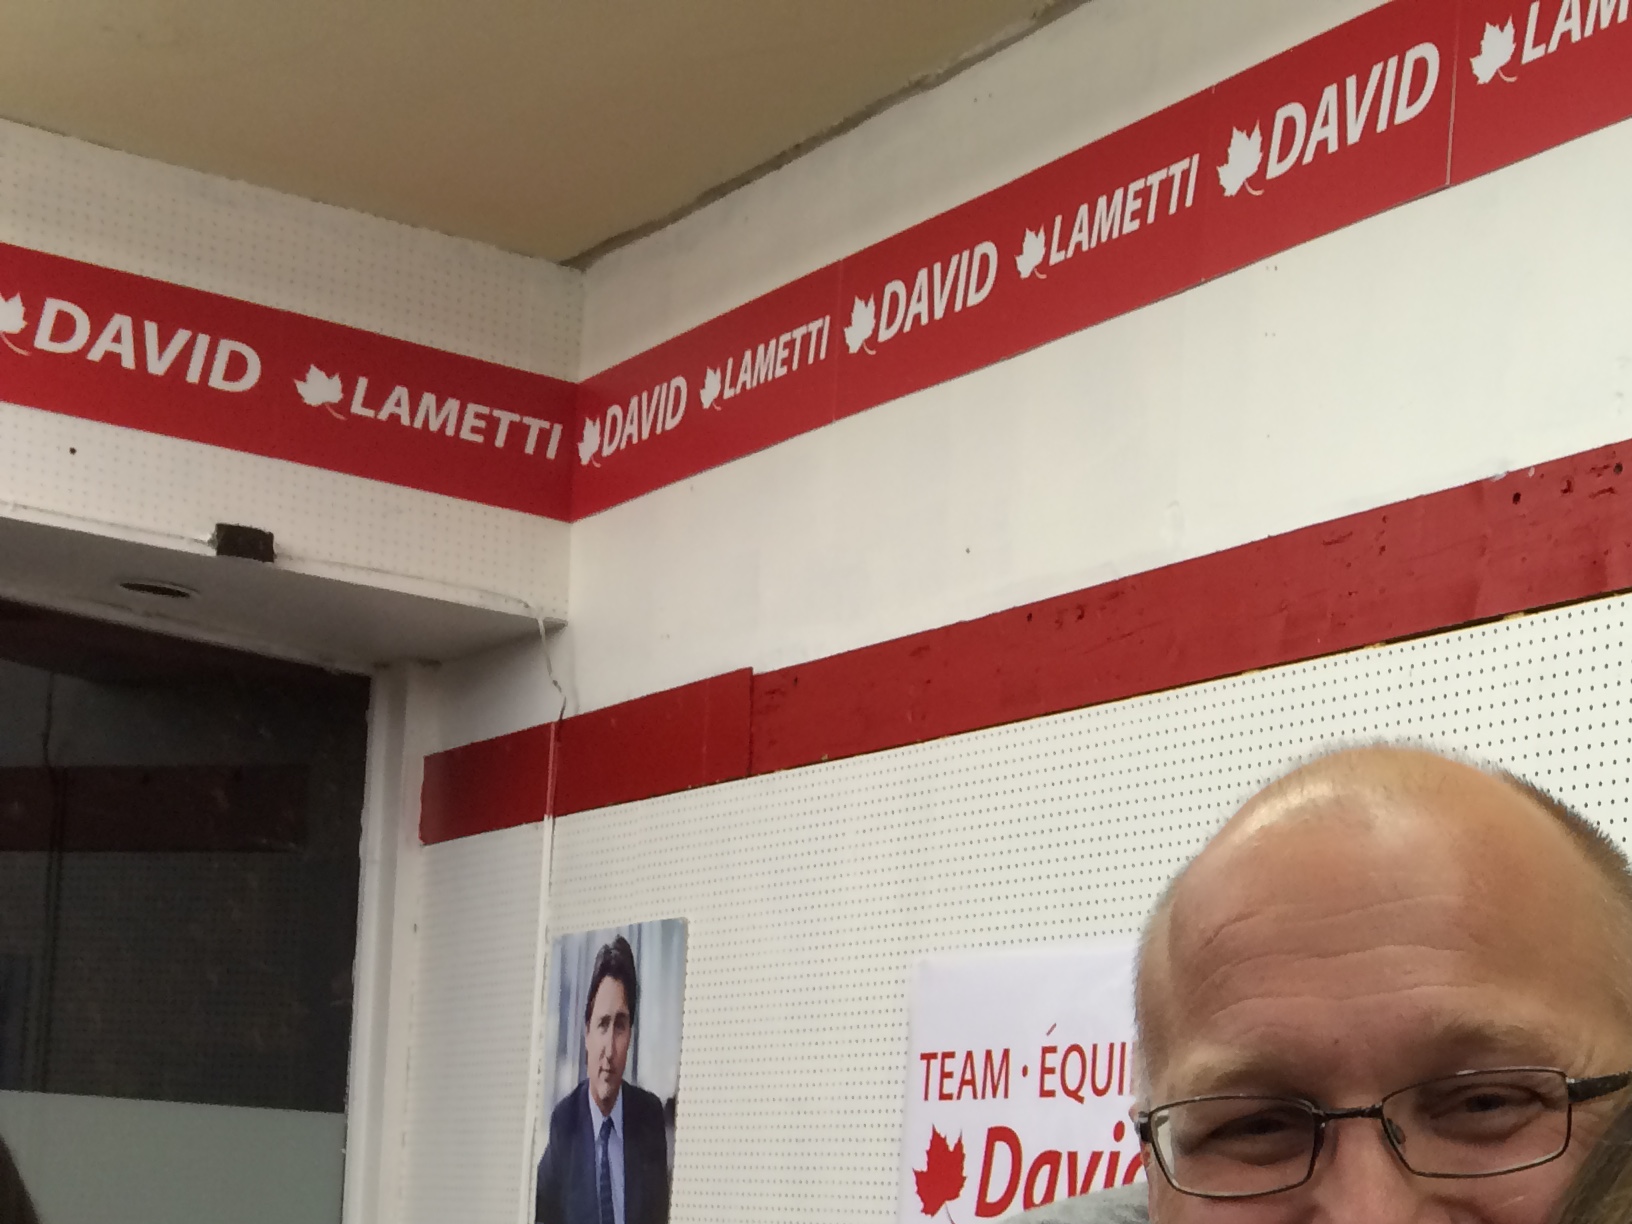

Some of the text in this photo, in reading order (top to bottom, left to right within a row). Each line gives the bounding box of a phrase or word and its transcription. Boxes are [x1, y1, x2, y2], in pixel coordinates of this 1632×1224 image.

[602, 376, 687, 456] DAVID
[723, 315, 830, 399] LAMETTI
[878, 241, 997, 342] DAVID
[1049, 154, 1199, 266] LAMETTI
[1266, 42, 1439, 180] DAVID
[34, 298, 562, 459] DAVID LAMETTI
[920, 1048, 1010, 1101] TEAM
[1039, 1023, 1138, 1104] ÉQUI
